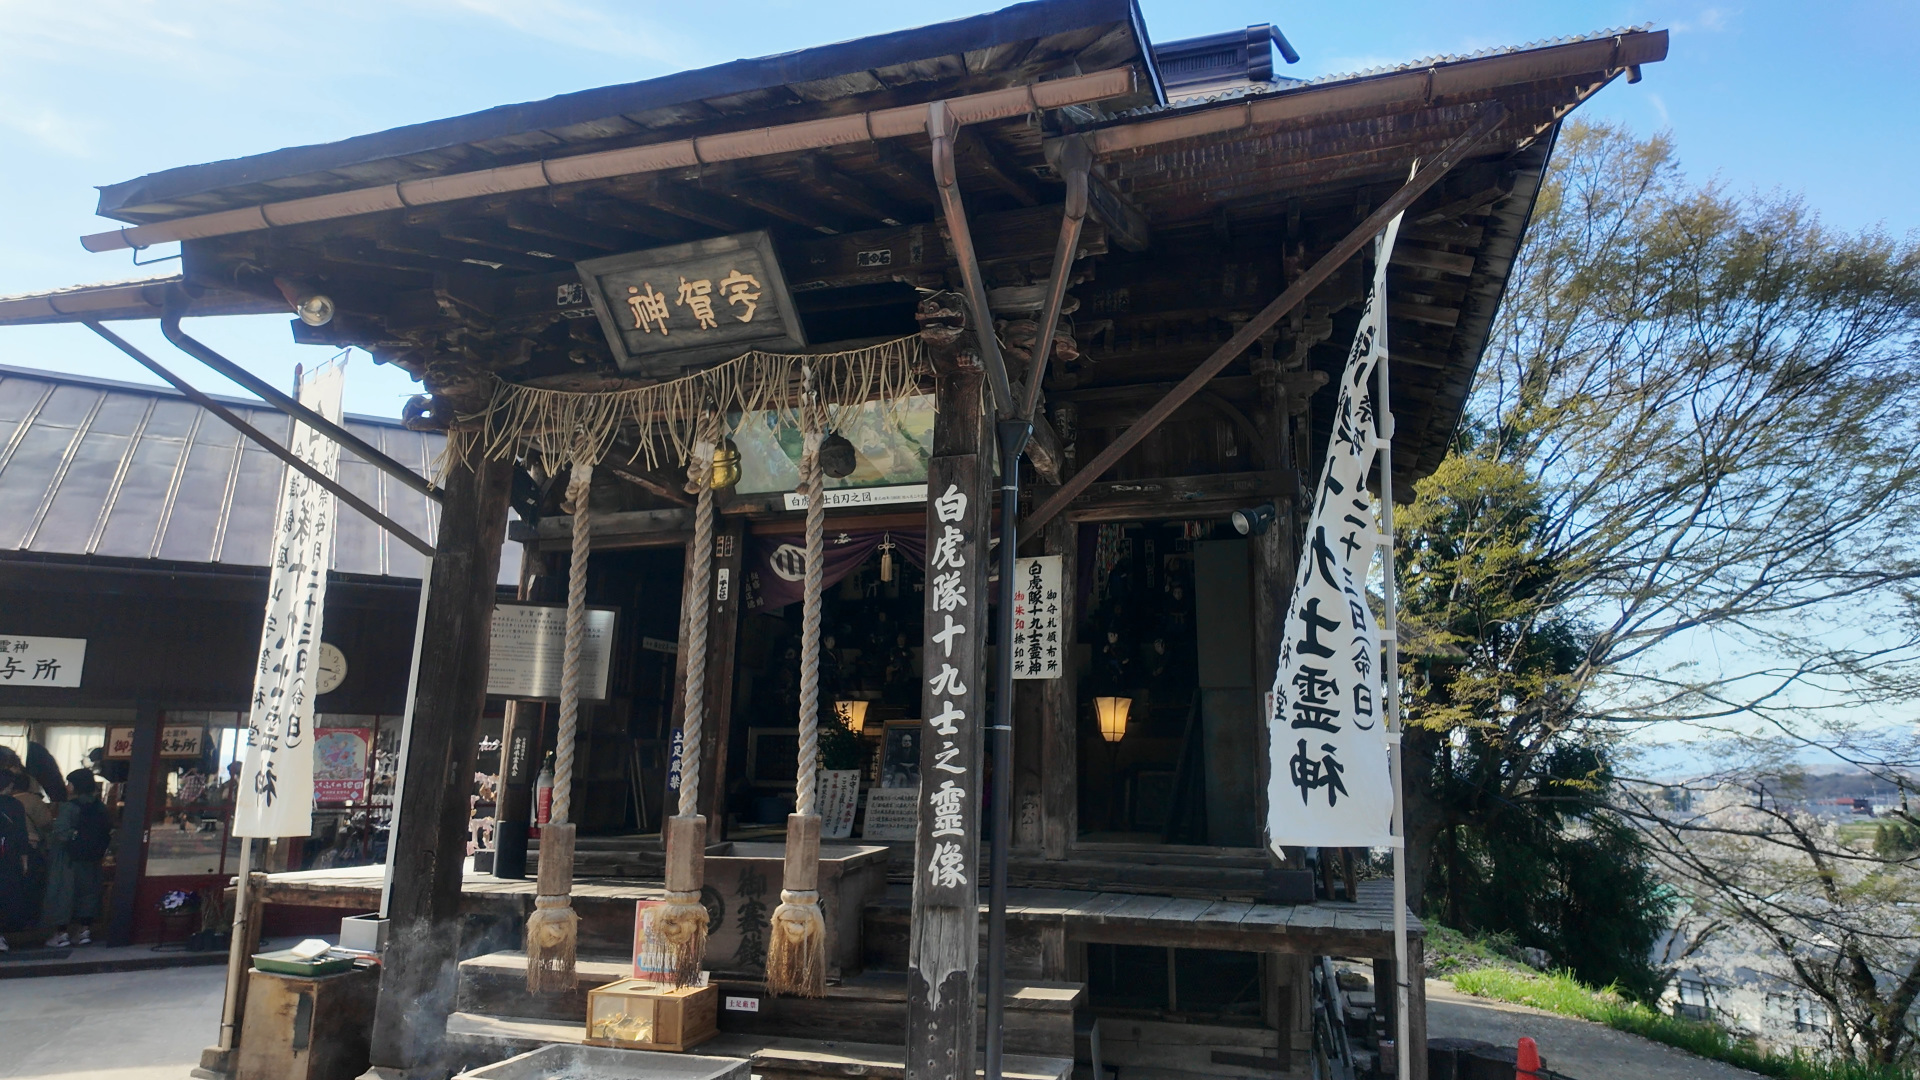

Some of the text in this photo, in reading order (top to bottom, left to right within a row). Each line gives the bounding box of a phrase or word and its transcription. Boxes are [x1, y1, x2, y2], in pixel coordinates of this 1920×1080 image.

[627, 269, 762, 336] 宇賀神
[791, 491, 872, 507] 白虎士自刃之図
